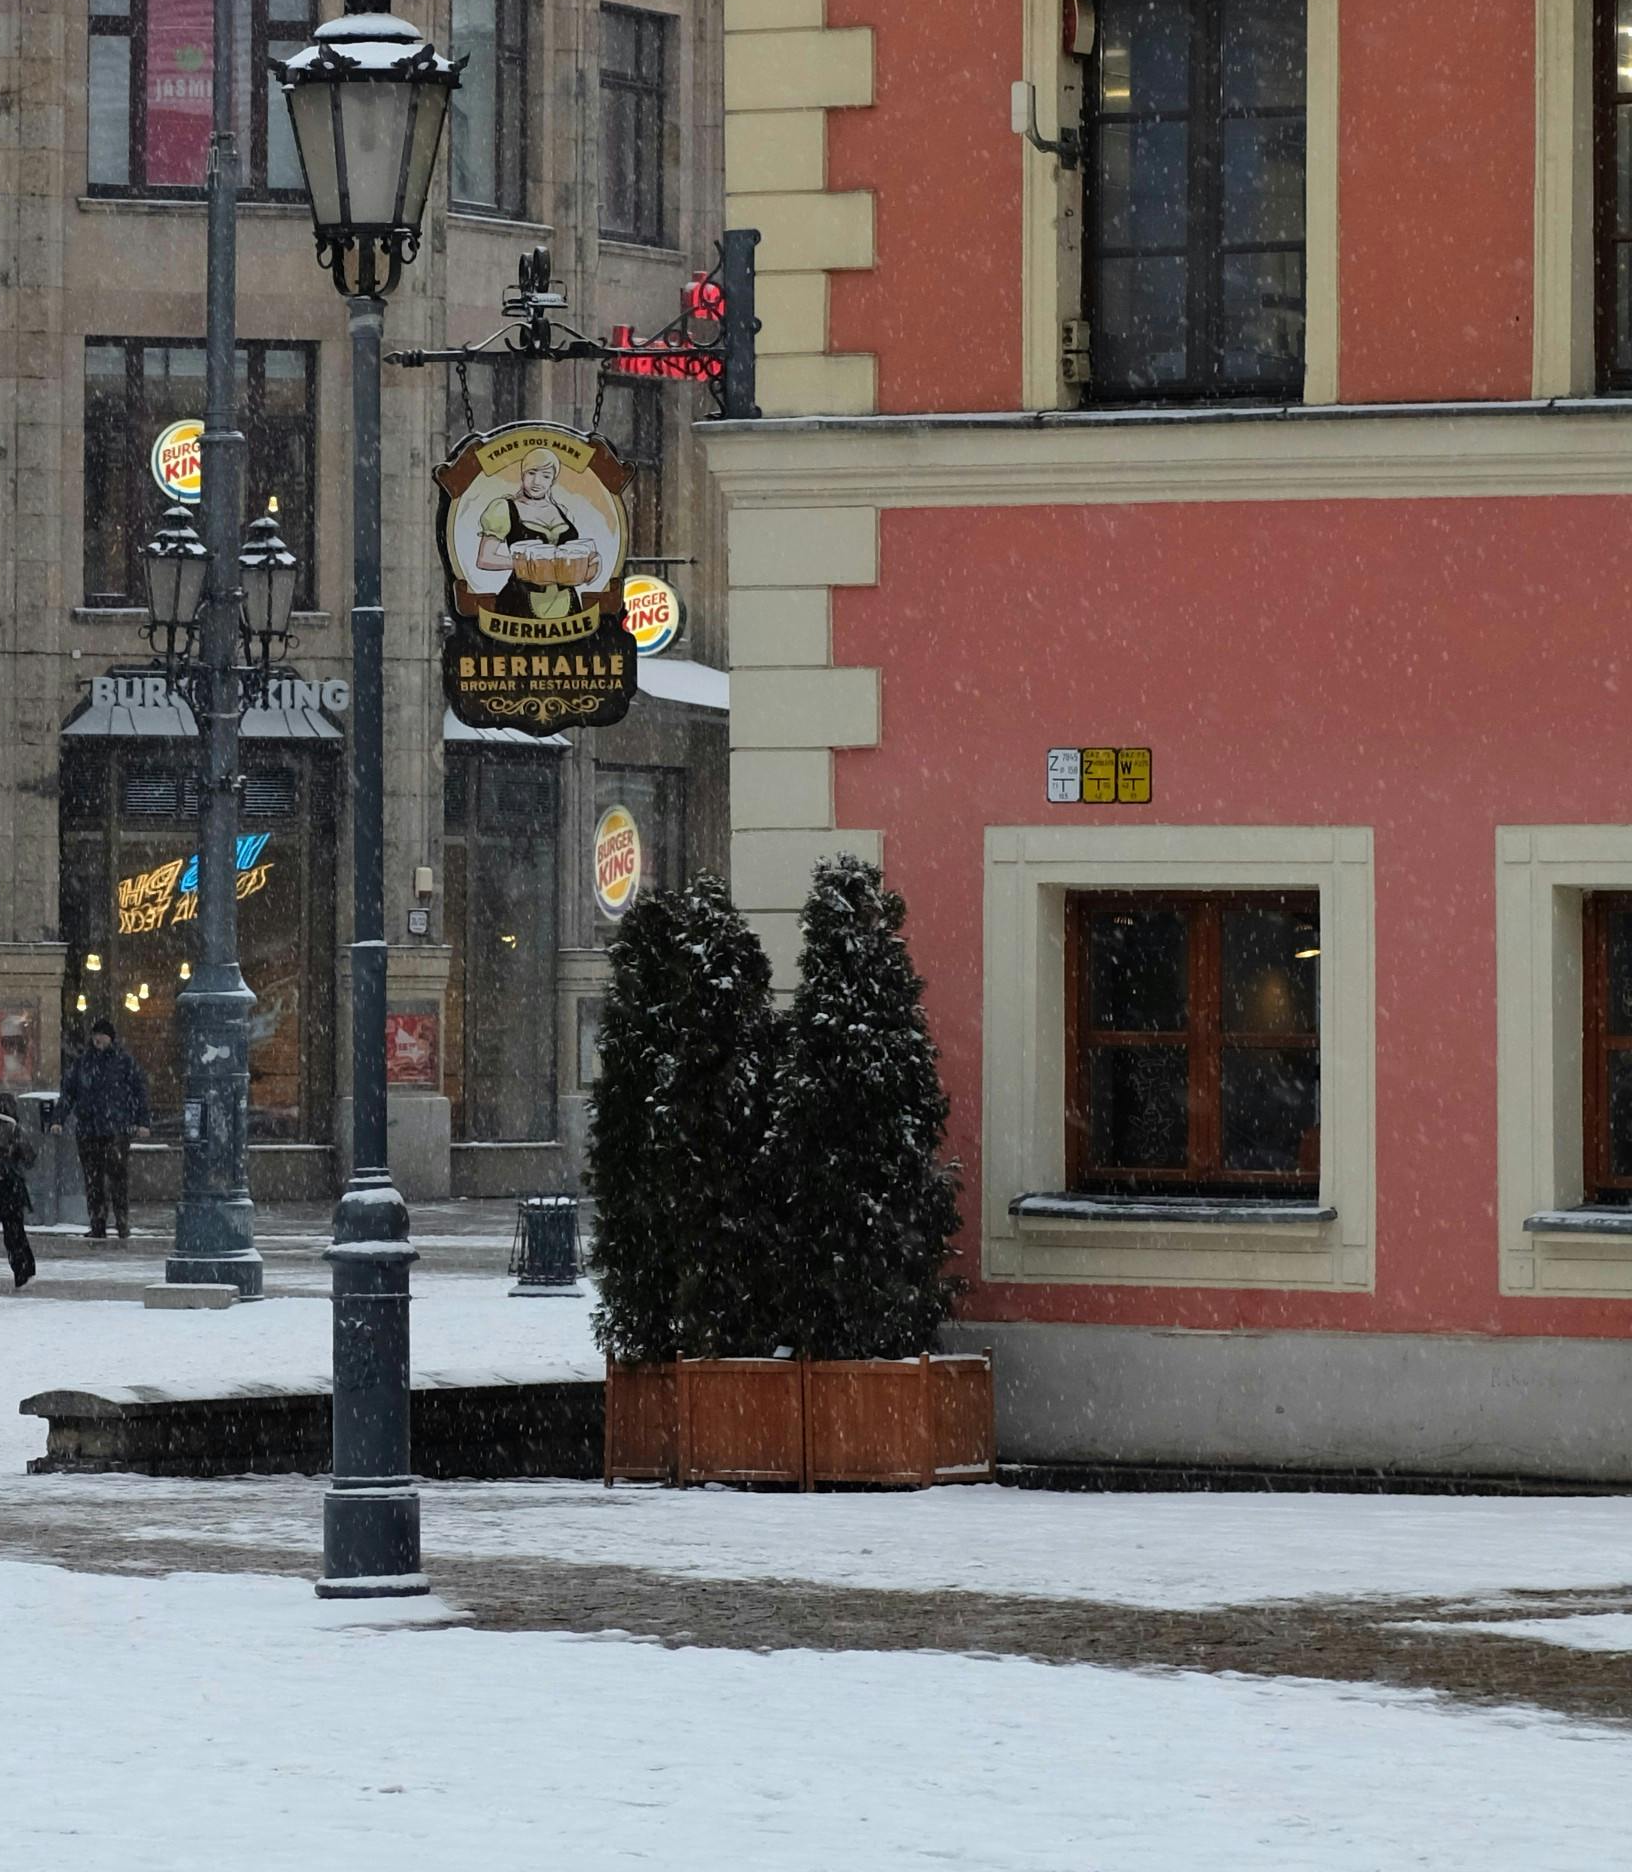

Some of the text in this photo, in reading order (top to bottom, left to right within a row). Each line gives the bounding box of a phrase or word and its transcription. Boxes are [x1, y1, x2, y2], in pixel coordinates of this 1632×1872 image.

[162, 442, 201, 464] BURG
[487, 438, 581, 461] TRADE 2005 MARK
[165, 455, 202, 483] KIN
[489, 616, 593, 639] BIERHALLE
[459, 655, 624, 677] BIERHALLE
[460, 679, 624, 692] BROWAR RESTAURACJA
[1120, 760, 1132, 775] W
[598, 829, 633, 865] BURGER
[599, 847, 634, 891] KING
